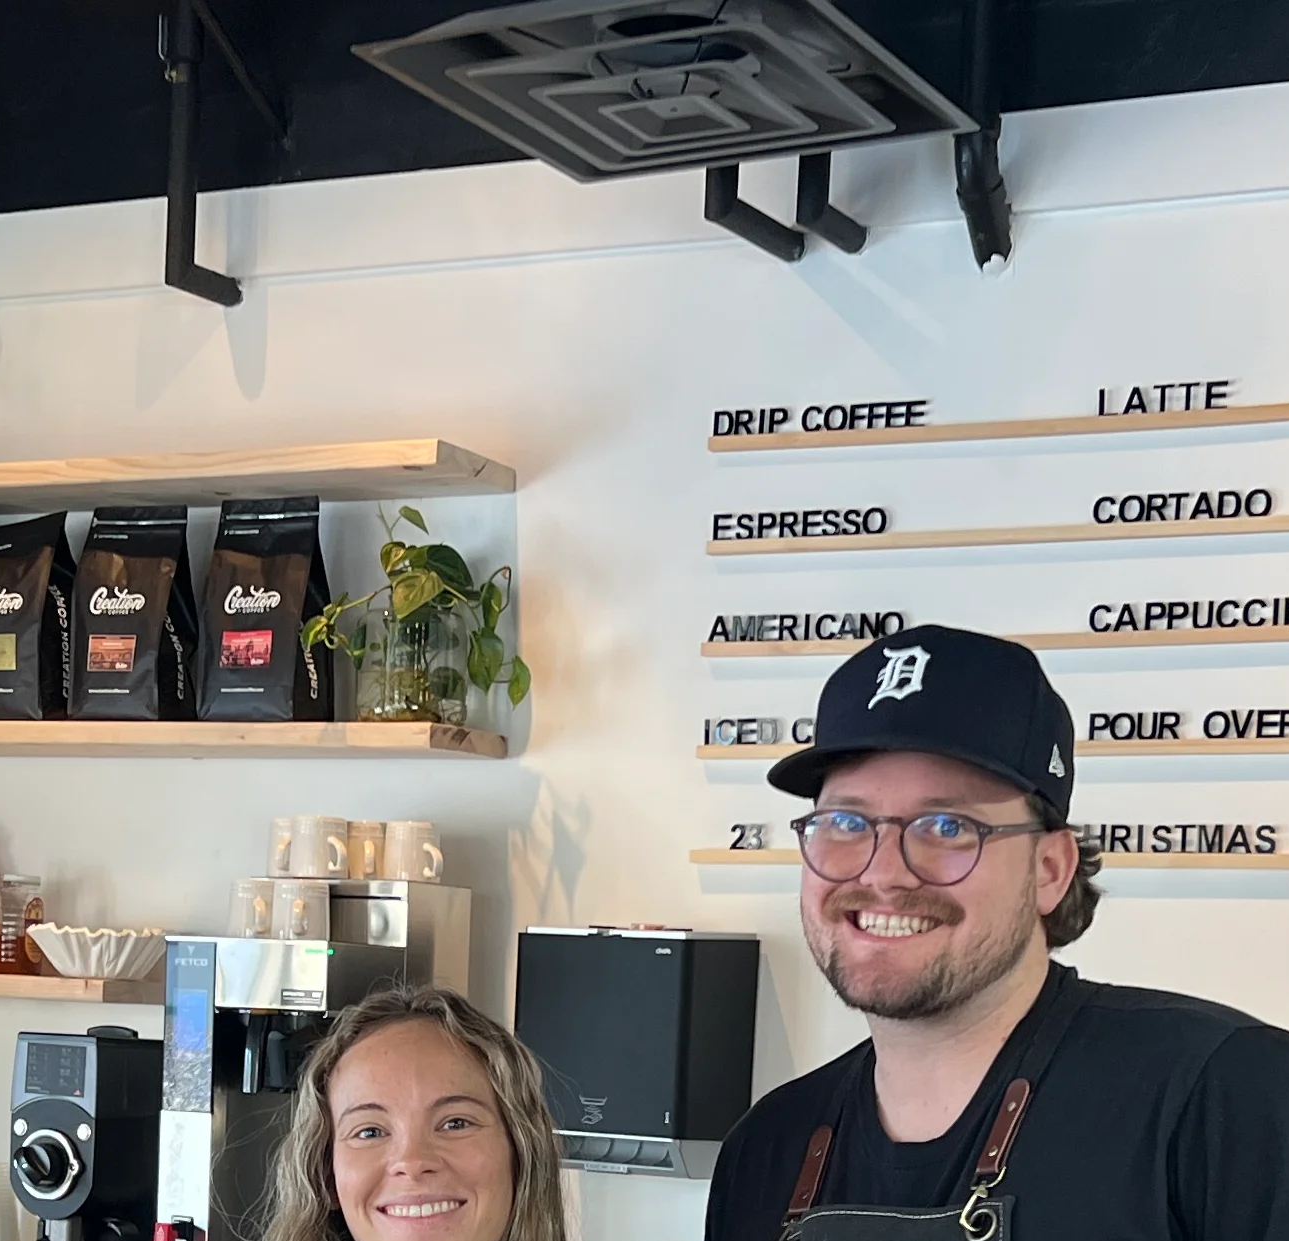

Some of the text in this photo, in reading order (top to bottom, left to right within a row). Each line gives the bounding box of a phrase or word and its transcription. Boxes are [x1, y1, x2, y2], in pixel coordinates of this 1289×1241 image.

[1098, 380, 1230, 416] LATTE
[713, 400, 927, 437] DRIP COFFEE
[1092, 489, 1273, 526] CORTADO
[712, 508, 887, 542] ESPRESSO
[89, 586, 146, 615] Creation
[224, 585, 281, 614] Creation
[708, 611, 905, 642] AMERICANO
[62, 630, 70, 699] CREATION
[704, 718, 778, 745] ICED
[1088, 711, 1181, 741] POUR
[729, 823, 763, 850] 23
[1082, 823, 1277, 854] HRISTMAS
[174, 957, 209, 968] FETCO
